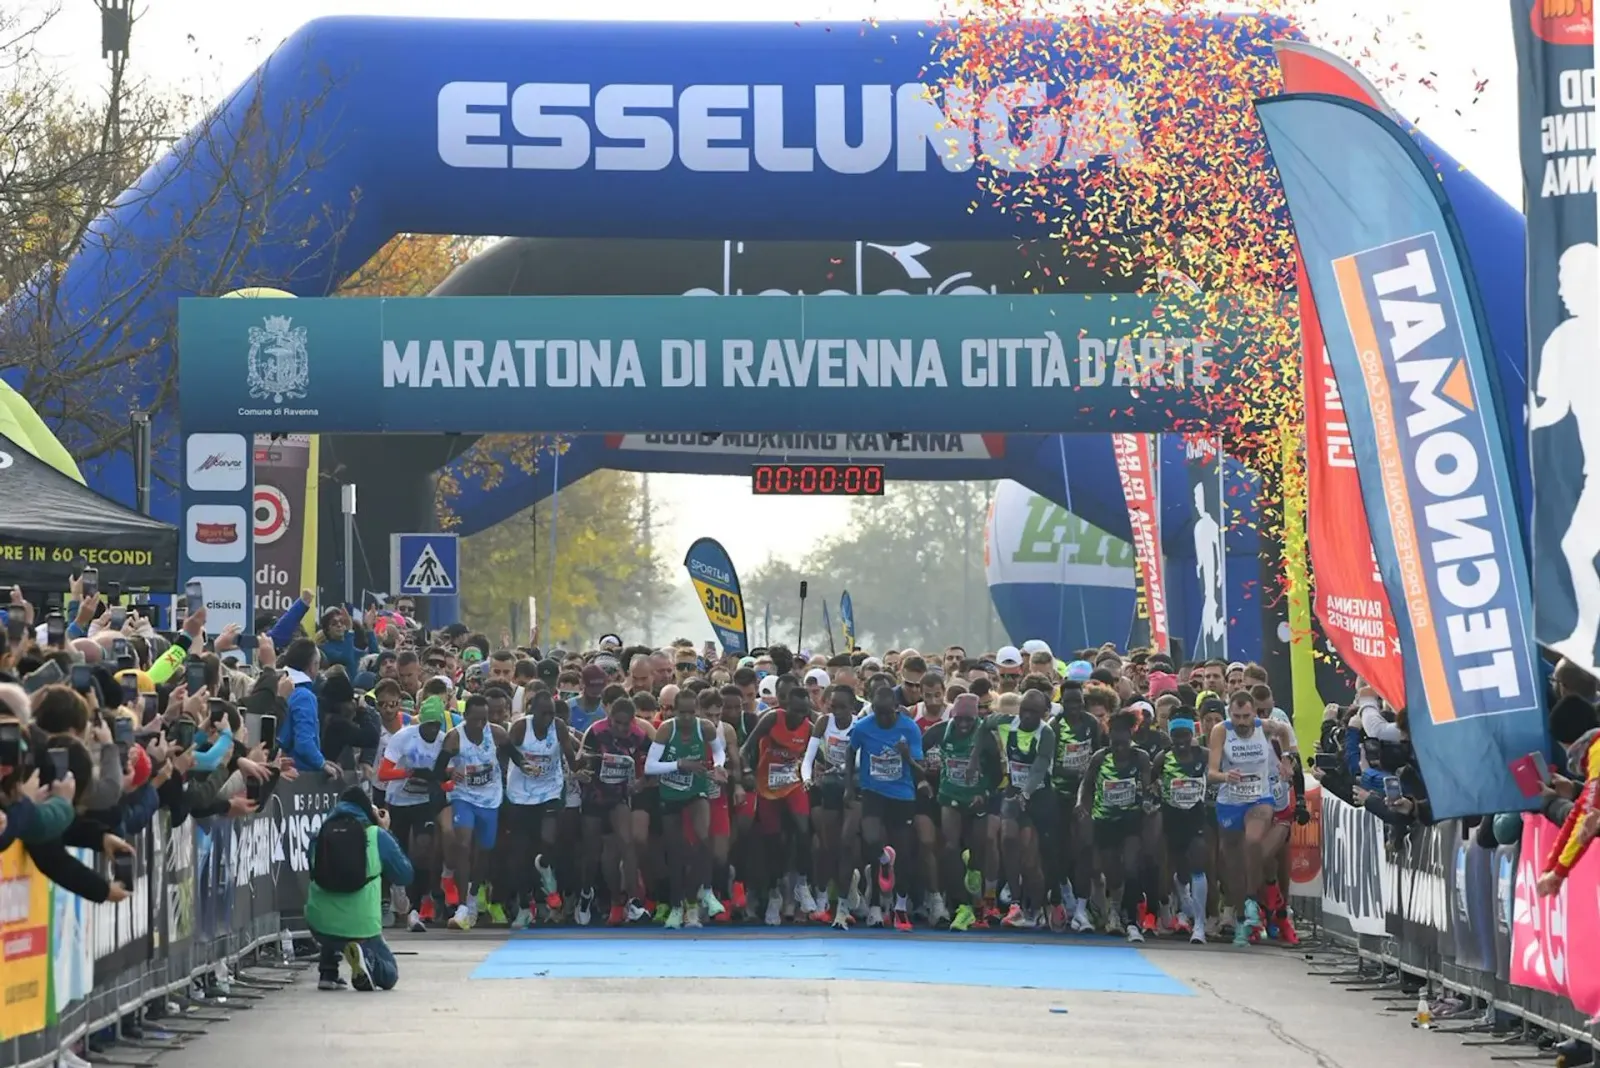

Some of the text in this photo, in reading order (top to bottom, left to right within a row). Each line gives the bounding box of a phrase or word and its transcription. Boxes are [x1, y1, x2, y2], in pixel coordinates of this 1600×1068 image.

[437, 80, 1142, 174] ESSELUNGA
[383, 331, 1216, 387] MARATONA DI RAVENNA CITTÀ D'ARTE
[238, 408, 319, 416] Comune di Ravenna
[846, 433, 964, 453] RAVENNA
[755, 466, 881, 494] 00:00:00
[29, 546, 46, 561] IN
[52, 548, 73, 562] 60
[79, 549, 152, 566] SECONDI
[706, 588, 737, 619] 3:00
[300, 793, 339, 811] SPORT
